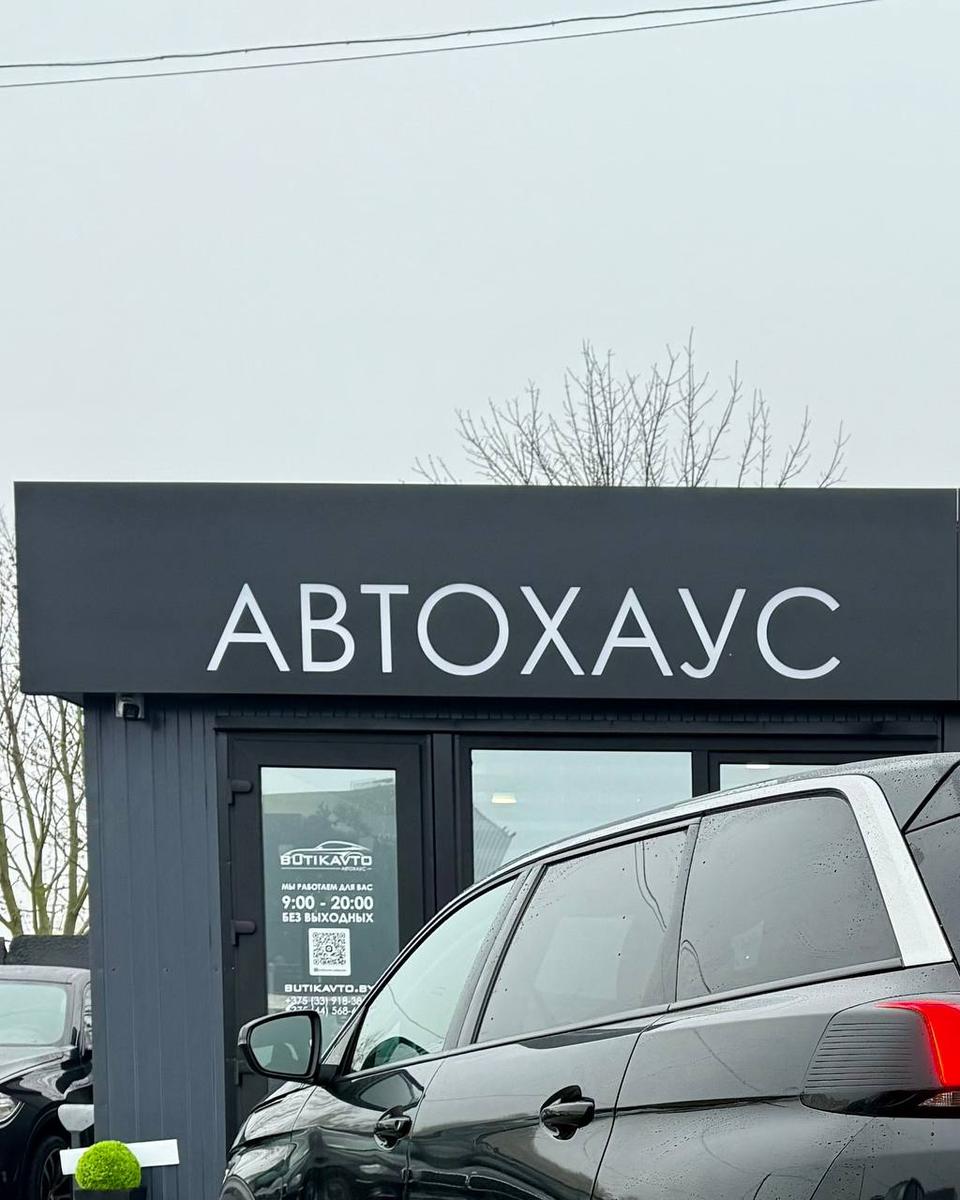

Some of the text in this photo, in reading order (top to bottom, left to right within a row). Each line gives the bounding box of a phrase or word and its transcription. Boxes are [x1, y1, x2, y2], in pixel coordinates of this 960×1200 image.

[207, 582, 841, 680] АВТОХАУС
[280, 855, 373, 866] BUTIKAVTO
[281, 883, 374, 892] МЫ РАБОТАЕМ ДЛЯ ВАС
[281, 895, 315, 910] 9:00
[330, 895, 374, 911] 20:00
[282, 912, 374, 924] БЕЗ ВЫХОДНЫХ
